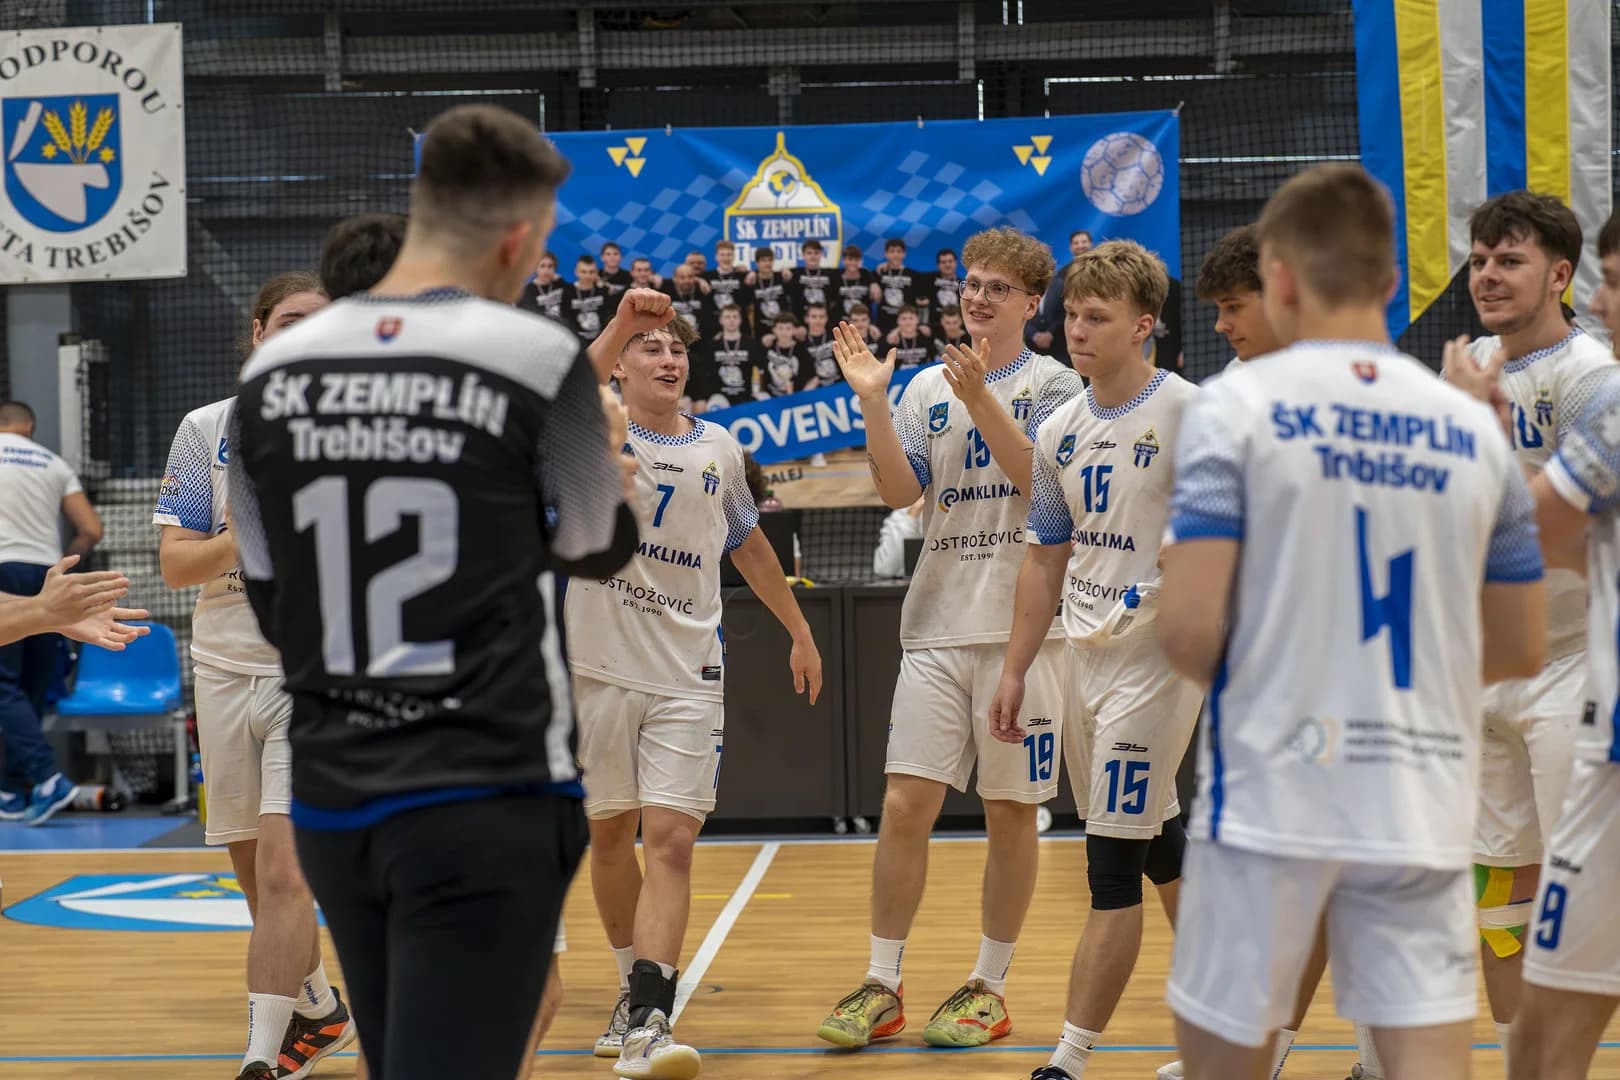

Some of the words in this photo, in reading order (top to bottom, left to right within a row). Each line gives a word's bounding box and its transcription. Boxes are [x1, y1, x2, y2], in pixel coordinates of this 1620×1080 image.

[0, 40, 166, 115] ODPOROU
[45, 170, 170, 269] TREBIŠOV
[735, 215, 758, 240] ŠK
[762, 214, 831, 239] ZEMPLÍN
[261, 370, 310, 421] ŠK
[317, 373, 510, 437] ZEMPLÍN
[1270, 401, 1324, 441] ŠK
[287, 416, 465, 463] Trebišov
[652, 483, 676, 529] 7
[1080, 464, 1114, 513] 15
[292, 475, 459, 677] 12
[1353, 505, 1416, 690] 4
[1023, 732, 1055, 782] 19
[1105, 760, 1151, 815] 15
[1534, 881, 1569, 951] 9
